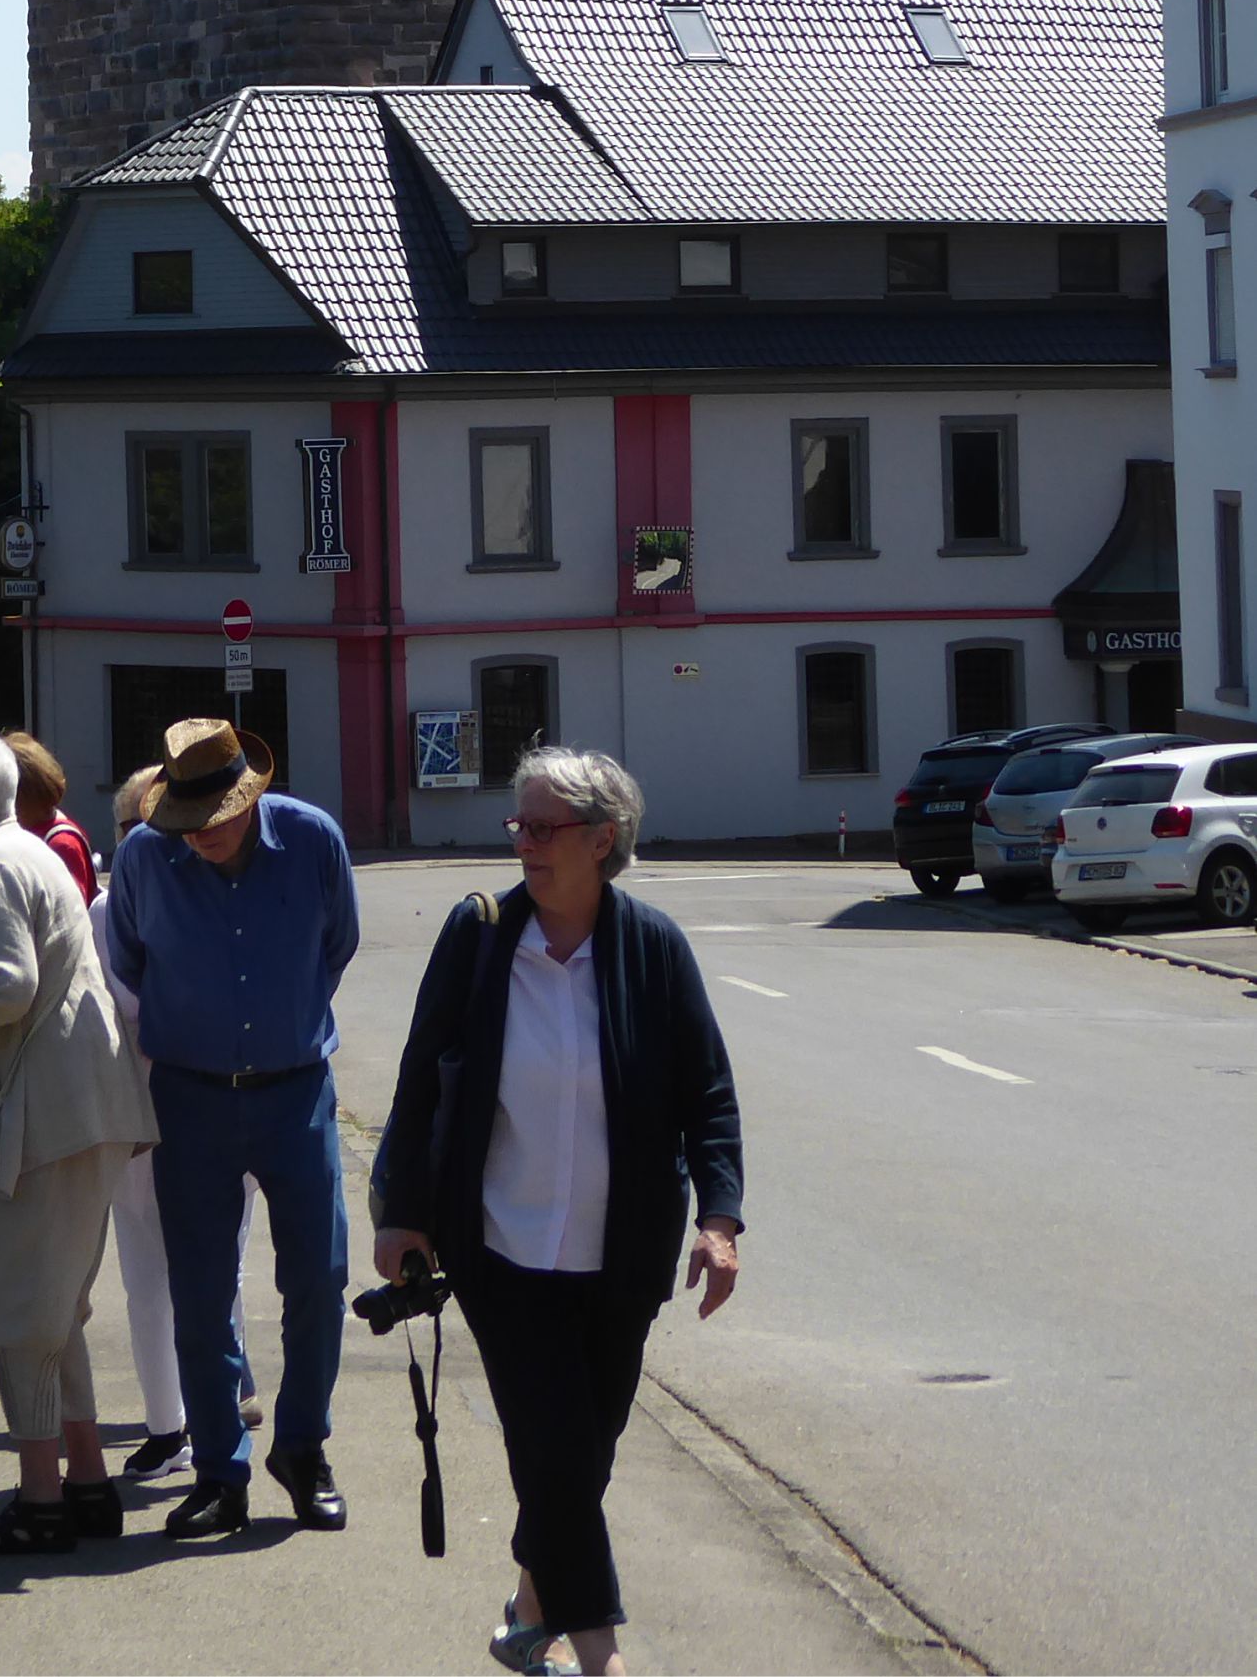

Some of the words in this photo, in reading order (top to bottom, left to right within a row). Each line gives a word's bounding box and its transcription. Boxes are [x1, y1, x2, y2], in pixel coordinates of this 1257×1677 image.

[319, 449, 334, 554] GASTHOF
[309, 559, 349, 570] RÖMER
[1106, 632, 1181, 650] GASTHO
